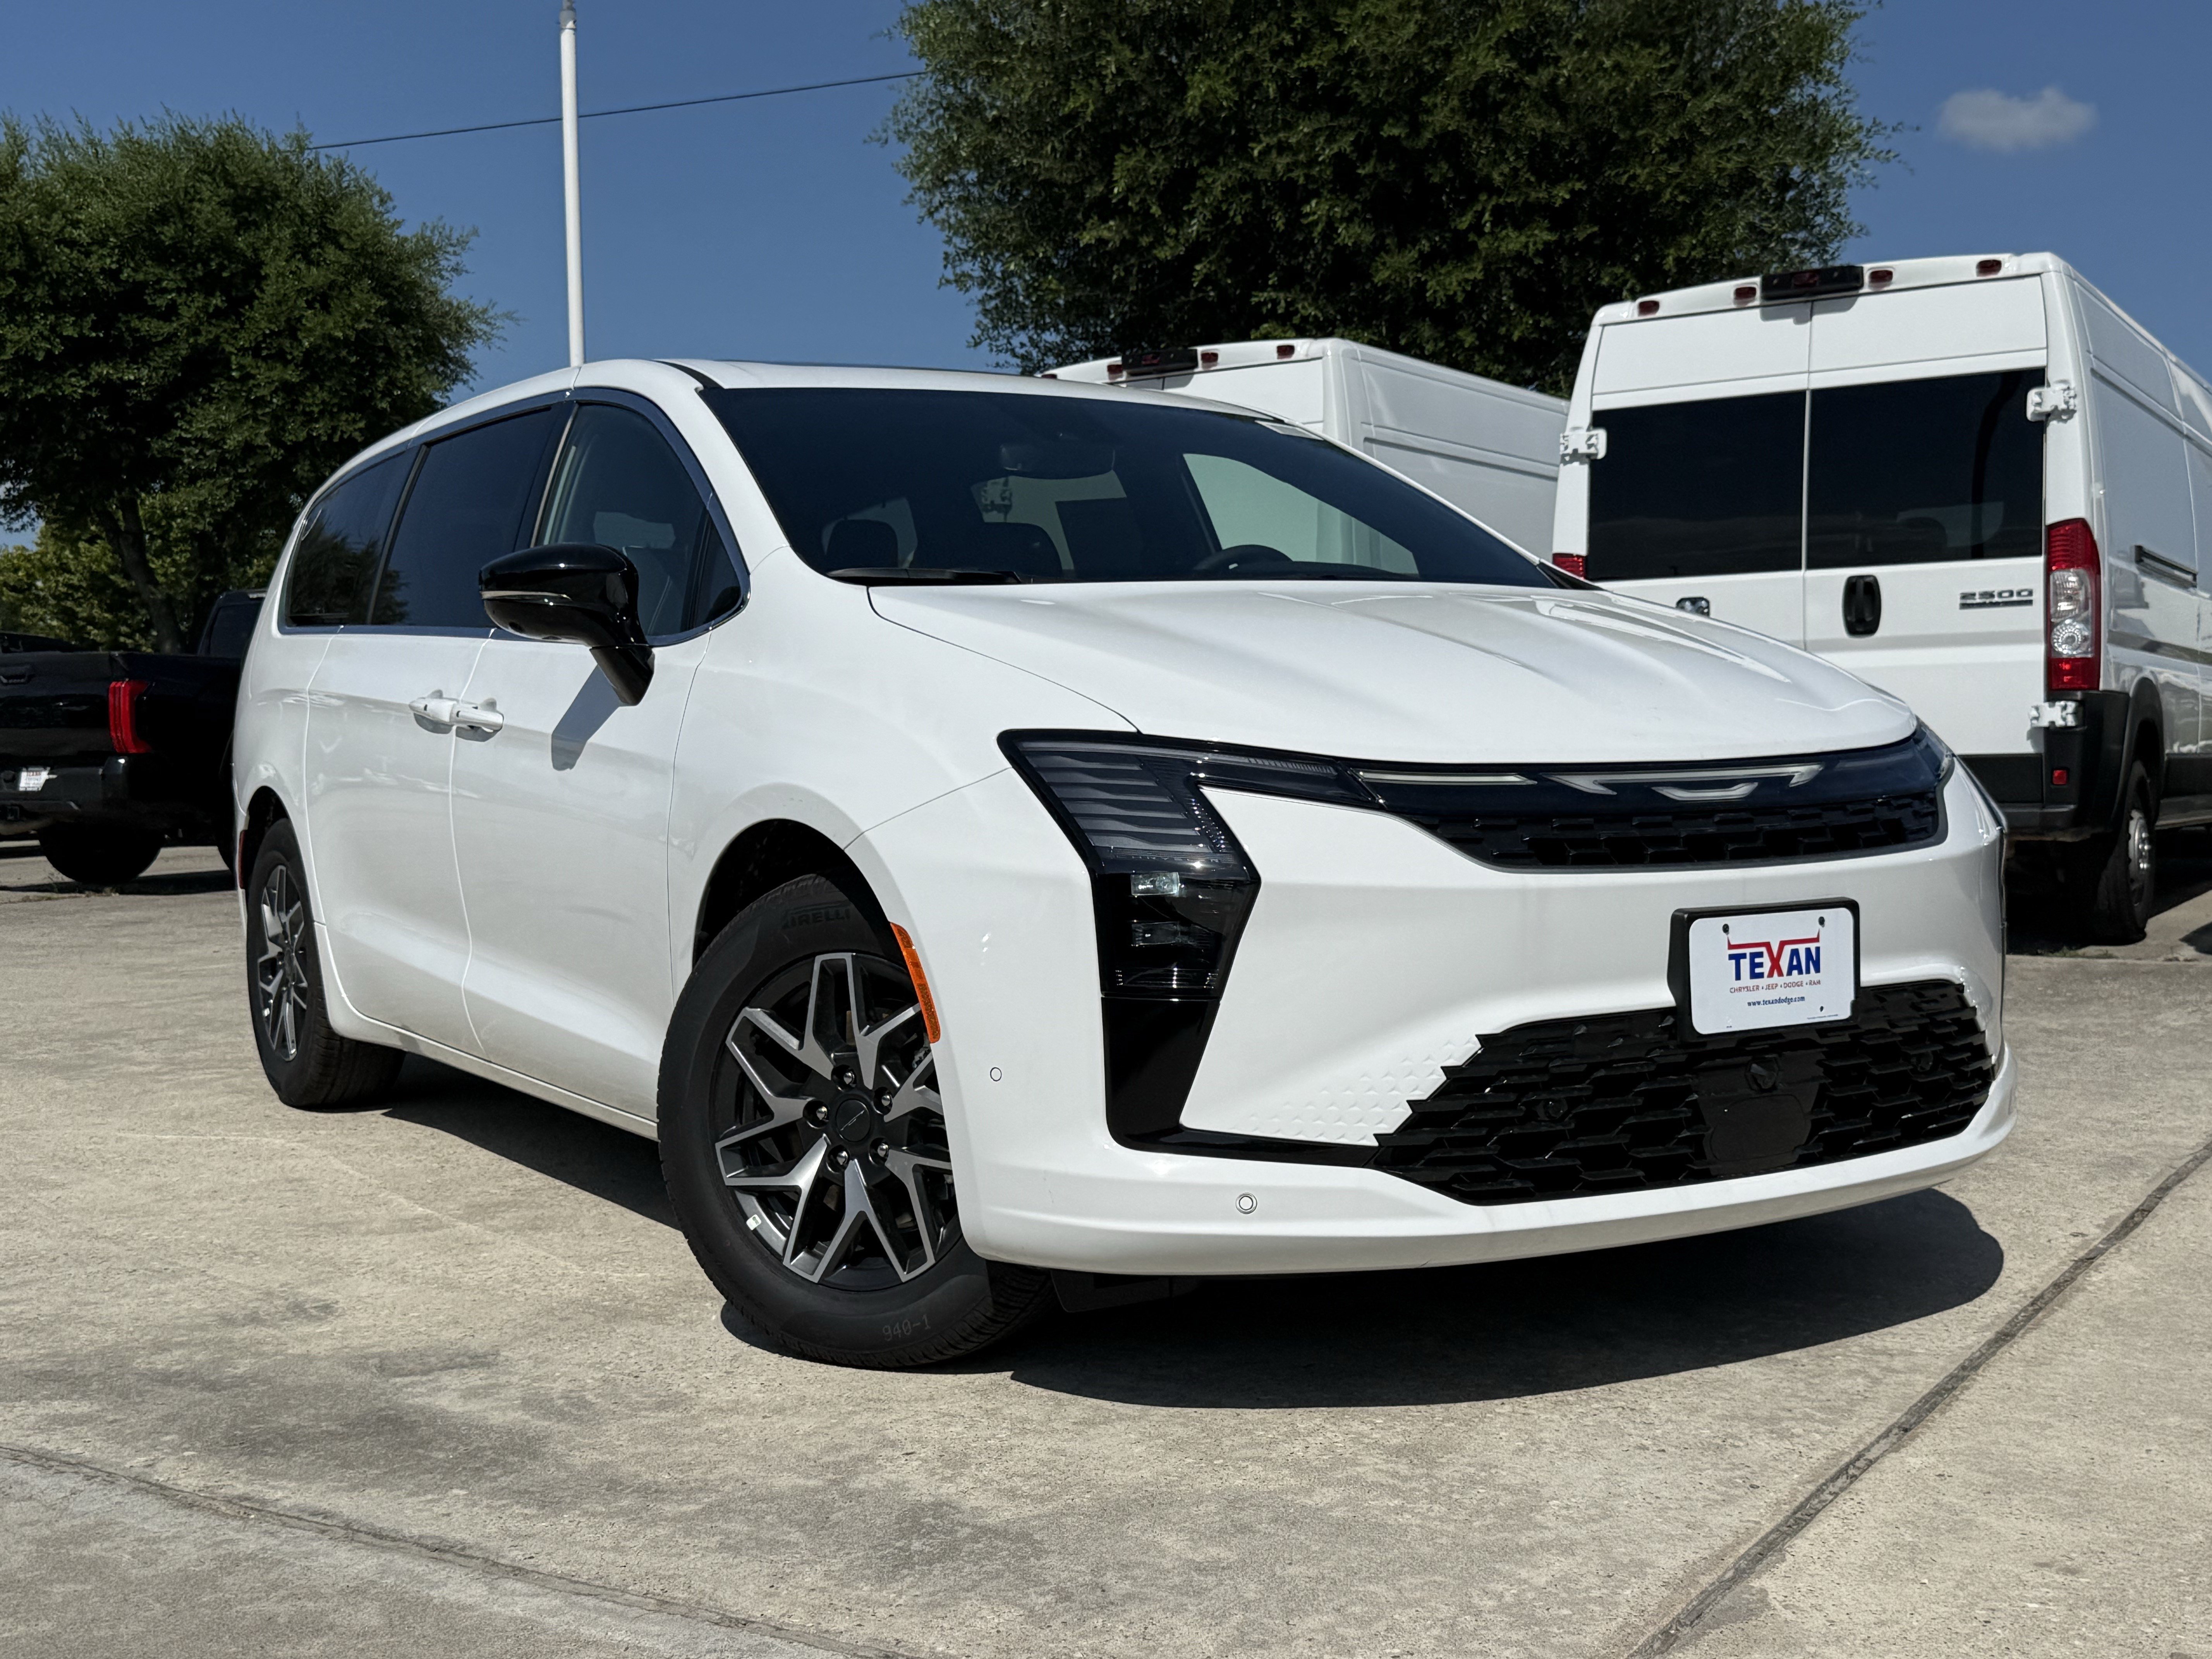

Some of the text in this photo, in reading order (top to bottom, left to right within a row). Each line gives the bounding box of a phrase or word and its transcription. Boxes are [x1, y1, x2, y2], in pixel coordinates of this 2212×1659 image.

[1960, 589, 2033, 600] 2500
[1728, 937, 1821, 981] TEXAN
[1729, 985, 1760, 993] CHRYSLER
[1783, 981, 1803, 989] DODGE
[1747, 996, 1805, 1006] www.texandodge.com
[883, 1314, 931, 1341] 940-1
